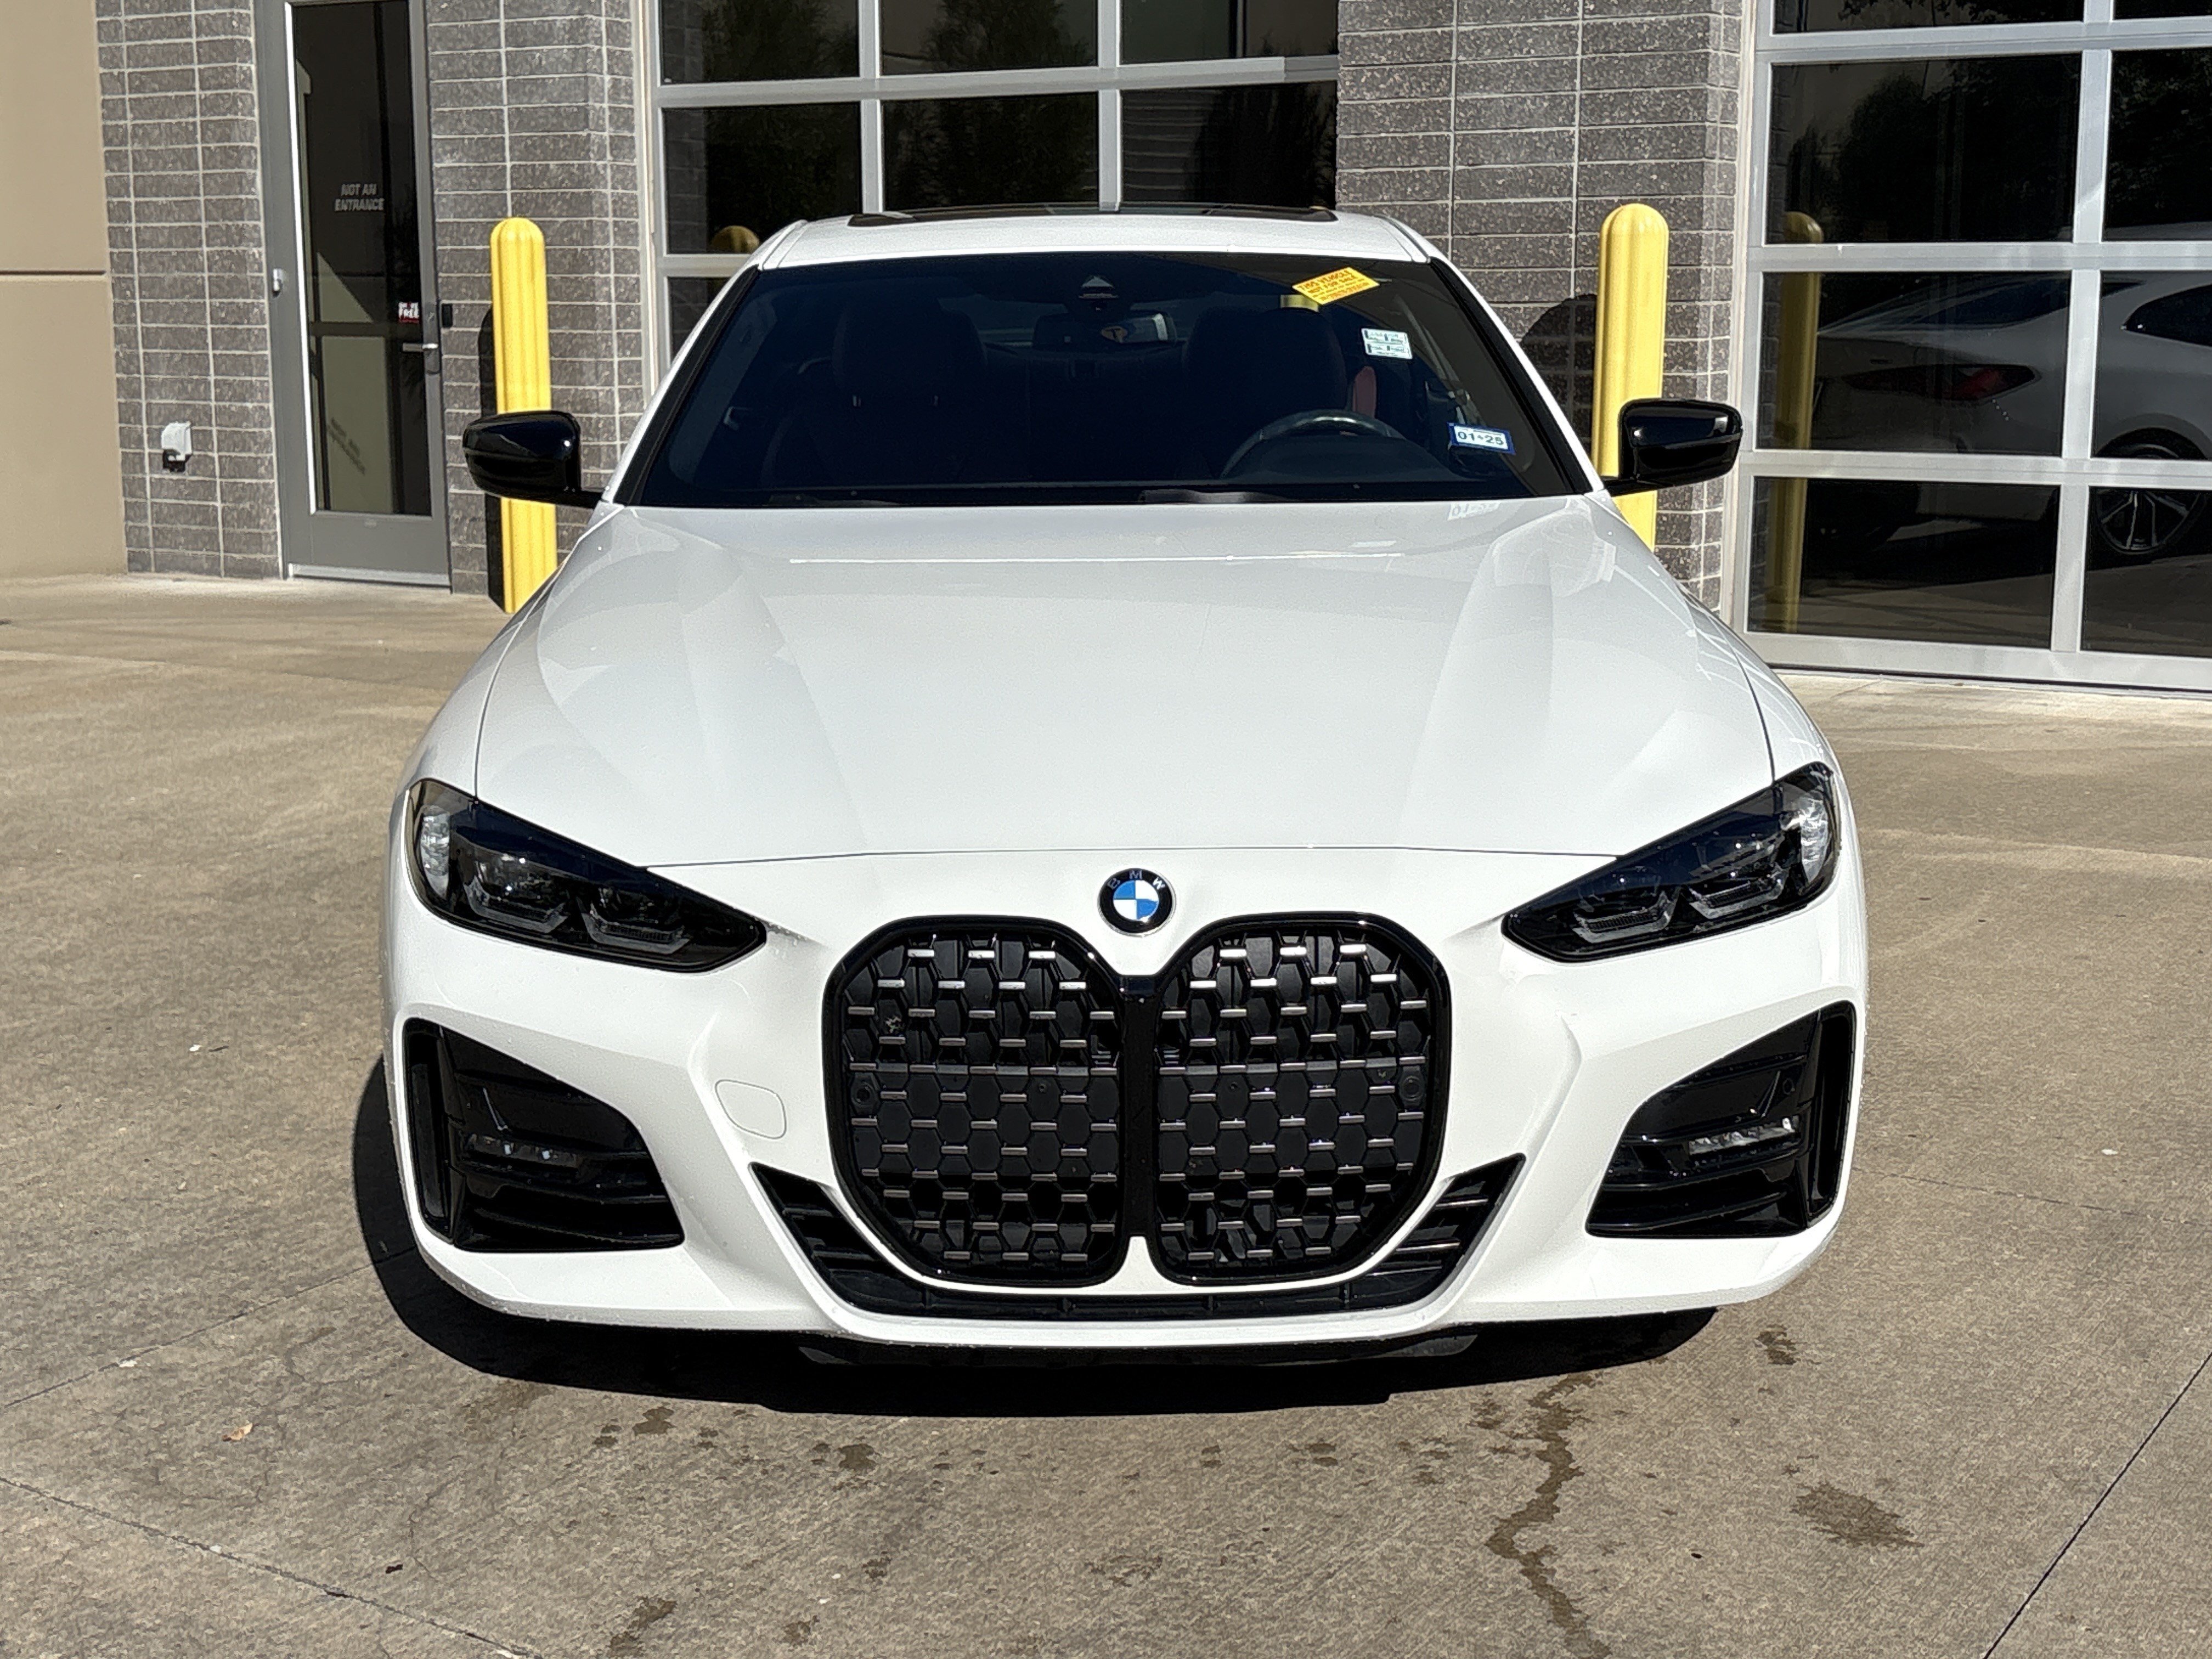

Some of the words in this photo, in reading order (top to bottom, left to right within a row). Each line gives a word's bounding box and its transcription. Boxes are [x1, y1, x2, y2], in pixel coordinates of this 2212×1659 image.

[341, 184, 360, 196] NOT
[362, 184, 377, 196] AN
[335, 198, 385, 211] ENTRANCE
[1107, 870, 1165, 890] BMW
